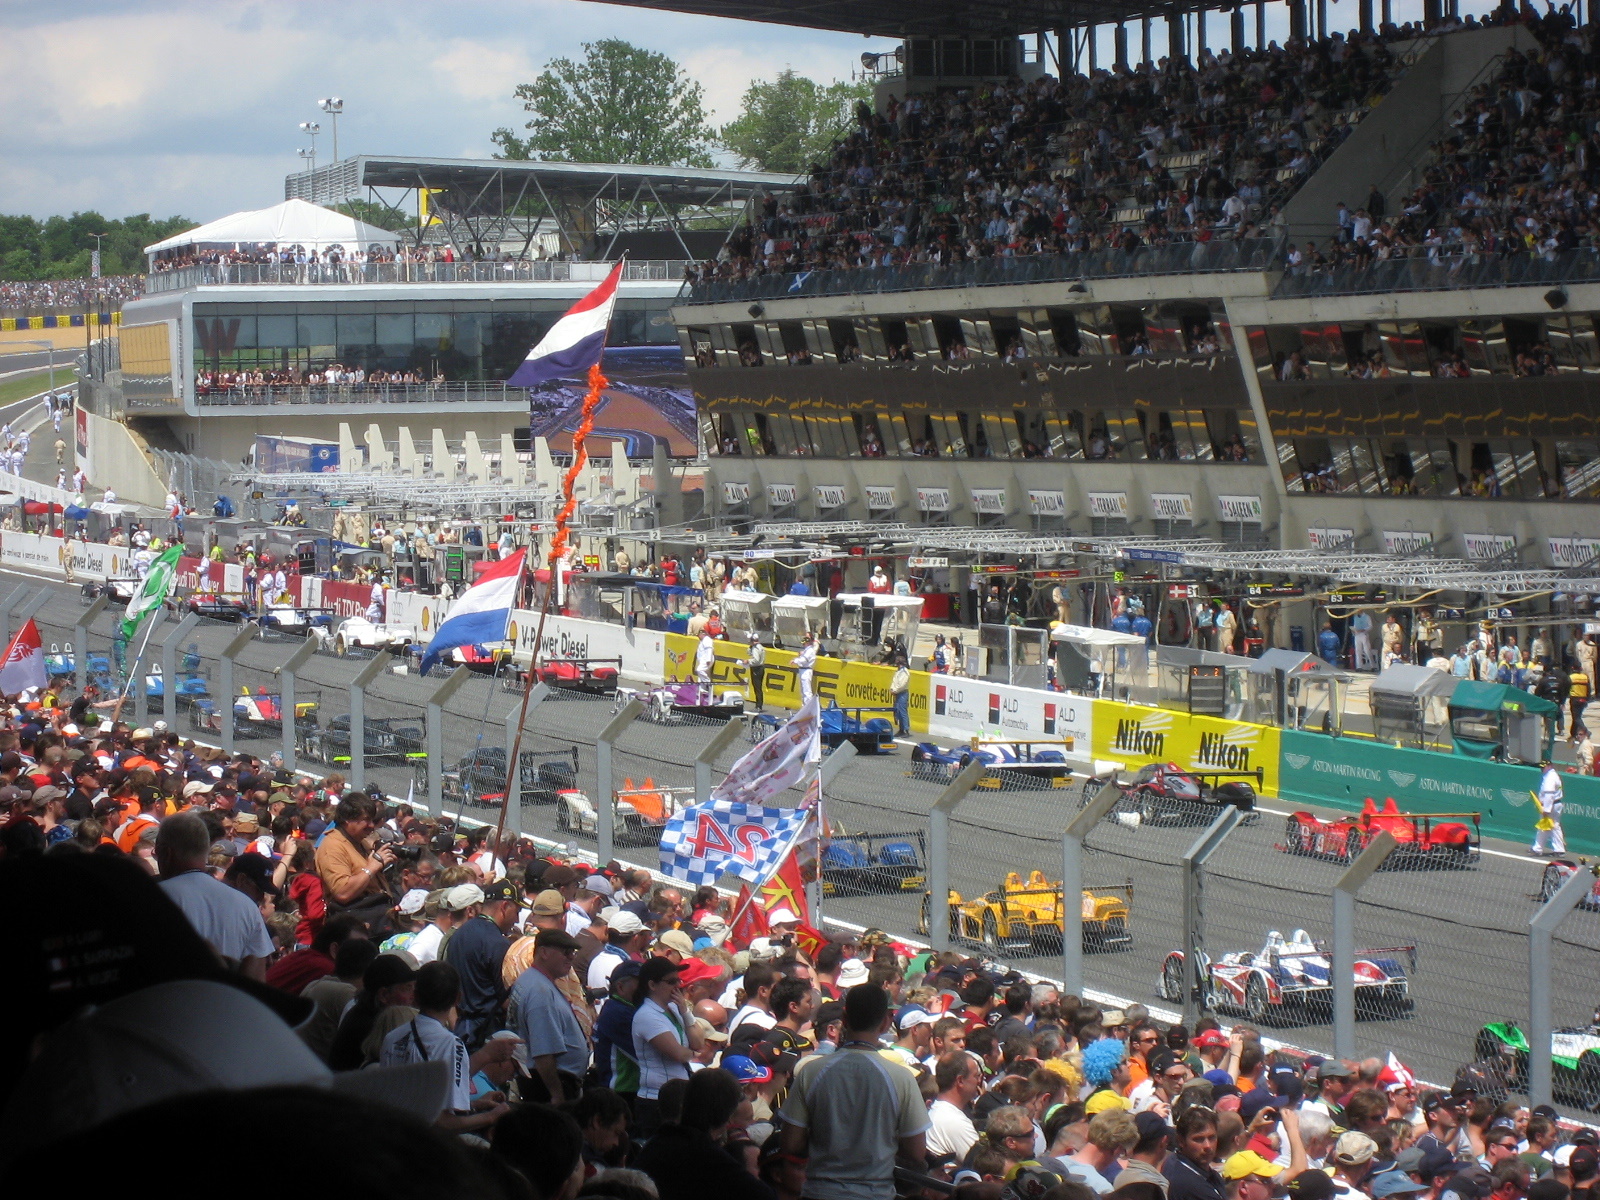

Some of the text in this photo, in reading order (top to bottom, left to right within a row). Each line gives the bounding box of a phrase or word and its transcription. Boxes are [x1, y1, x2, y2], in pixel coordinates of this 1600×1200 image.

[88, 553, 103, 572] Diesel
[323, 596, 341, 616] Audi
[1331, 594, 1342, 603] 63
[522, 625, 588, 659] V-Pwer Diesel
[949, 689, 964, 703] ALD
[1003, 698, 1018, 713] ALD
[948, 708, 973, 721] Automotive
[1060, 707, 1075, 722] ALD
[1002, 717, 1028, 731] Automotive
[1058, 726, 1086, 741] Automotive
[1116, 718, 1163, 757] Nikon
[1199, 731, 1249, 771] Nikon
[1313, 760, 1381, 781] ASTON MARTIN RACING
[1419, 778, 1493, 800] ASTON MARTIN RACING
